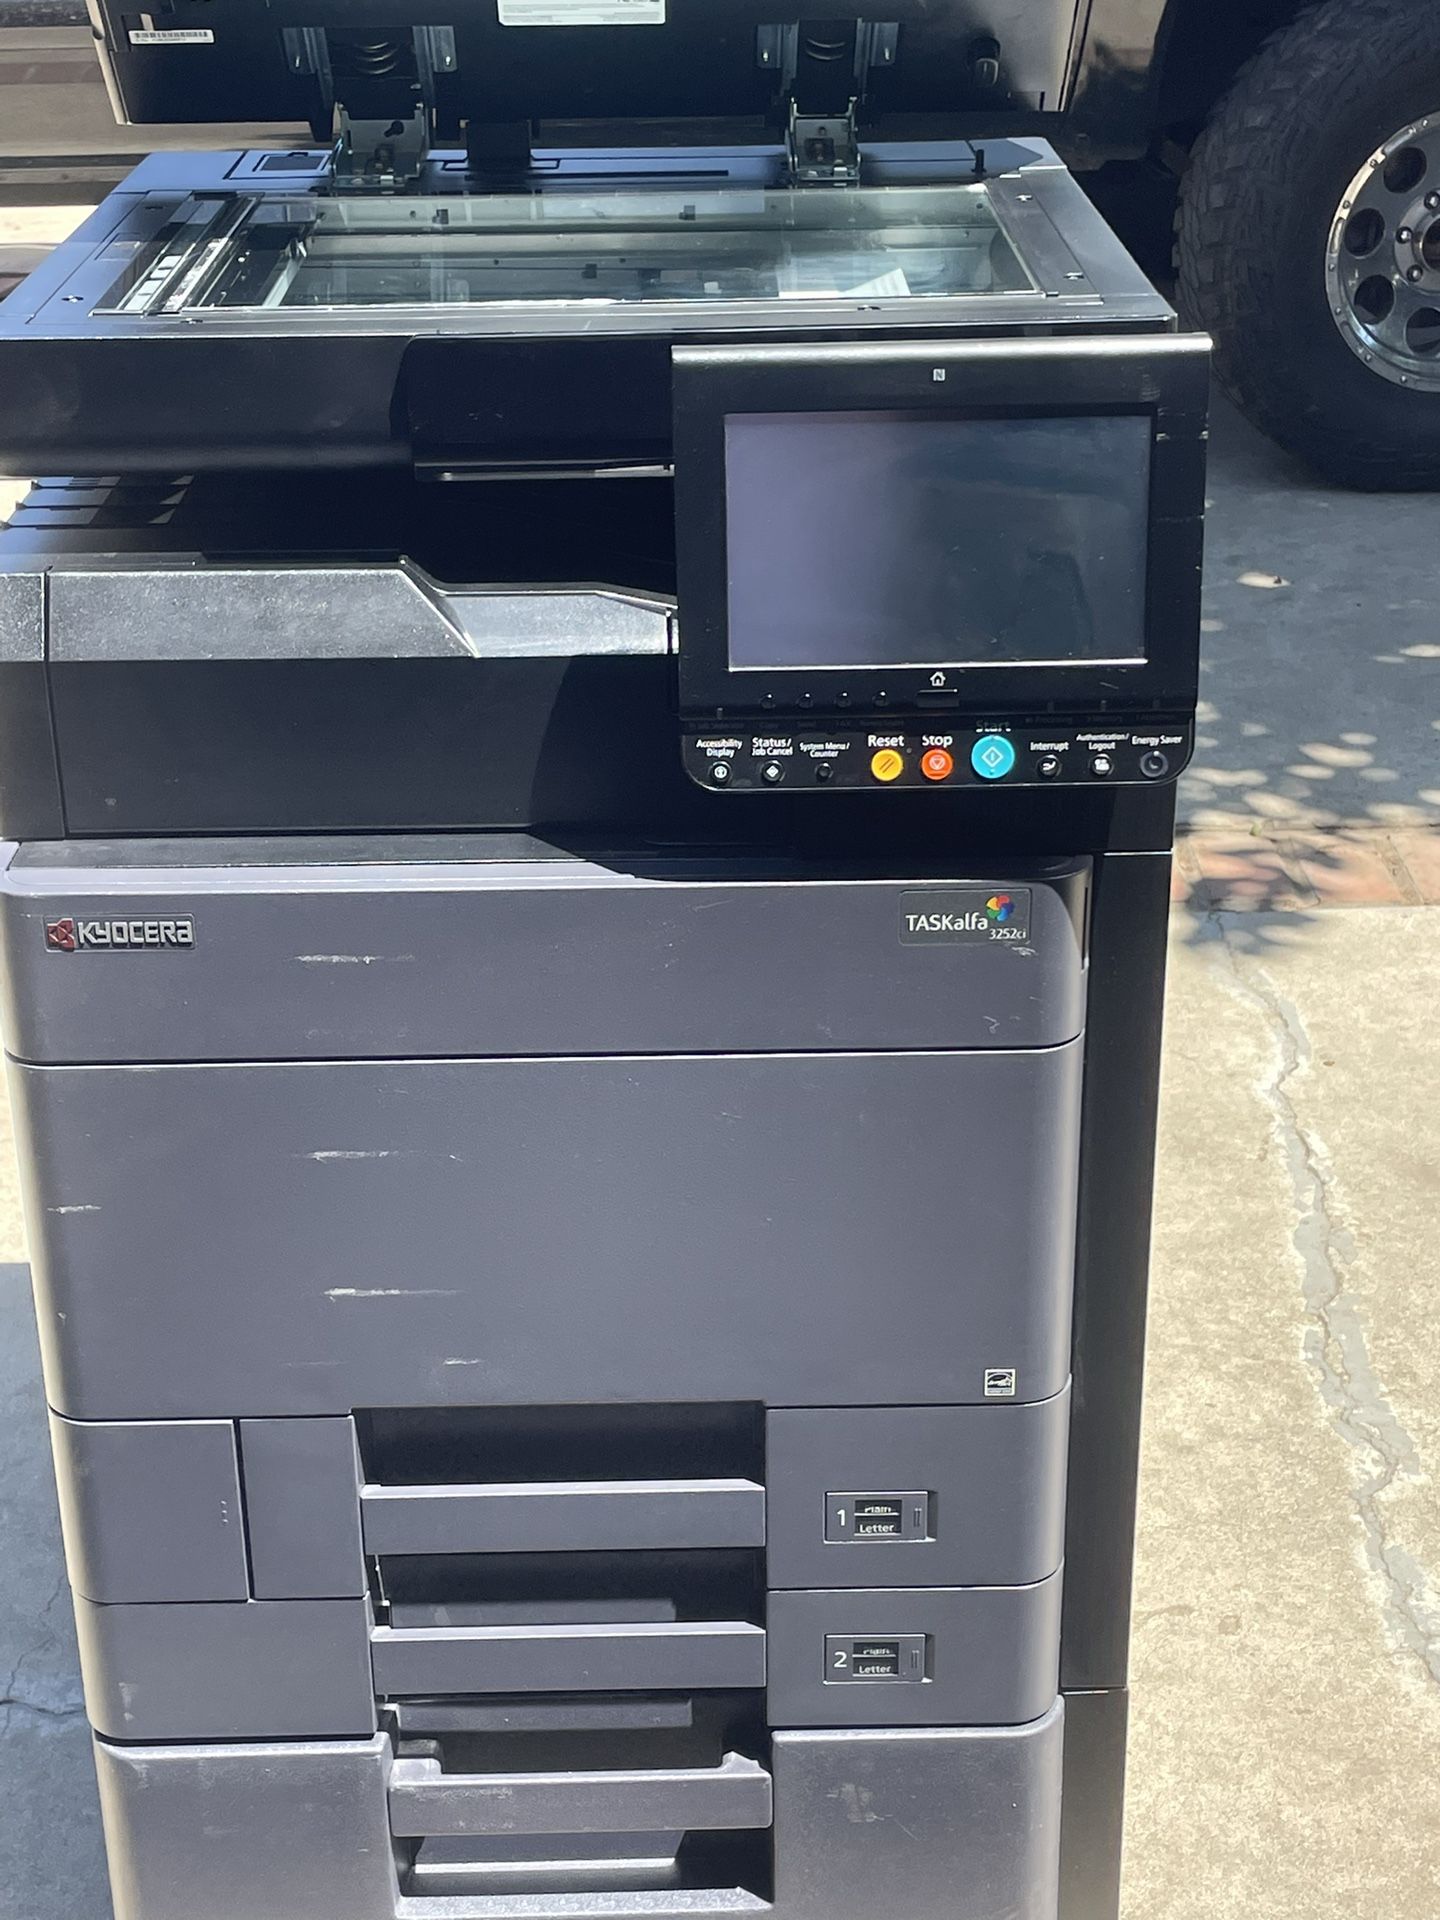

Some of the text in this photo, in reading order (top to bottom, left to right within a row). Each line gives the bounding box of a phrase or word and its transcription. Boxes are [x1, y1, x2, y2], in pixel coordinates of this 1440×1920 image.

[975, 719, 1011, 732] Start
[752, 736, 792, 748] Status/
[867, 735, 905, 747] Reset
[922, 735, 953, 748] Stop
[1076, 732, 1130, 742] Authentication/
[1132, 735, 1183, 747] Energy Saver
[696, 738, 743, 749] Accessibility
[799, 742, 850, 752] System Menu/
[1030, 741, 1069, 752] Interrupt
[1088, 742, 1116, 752] Logout
[706, 748, 735, 758] Display
[752, 747, 793, 757] Job Cancel
[809, 750, 839, 758] Counter
[905, 911, 988, 931] TASKalfa
[77, 920, 193, 945] KYOCERA
[989, 928, 1026, 940] 3252ci
[836, 1508, 846, 1526] 1
[859, 1524, 895, 1533] Letter
[833, 1651, 847, 1668] 2
[858, 1665, 891, 1674] Letter
